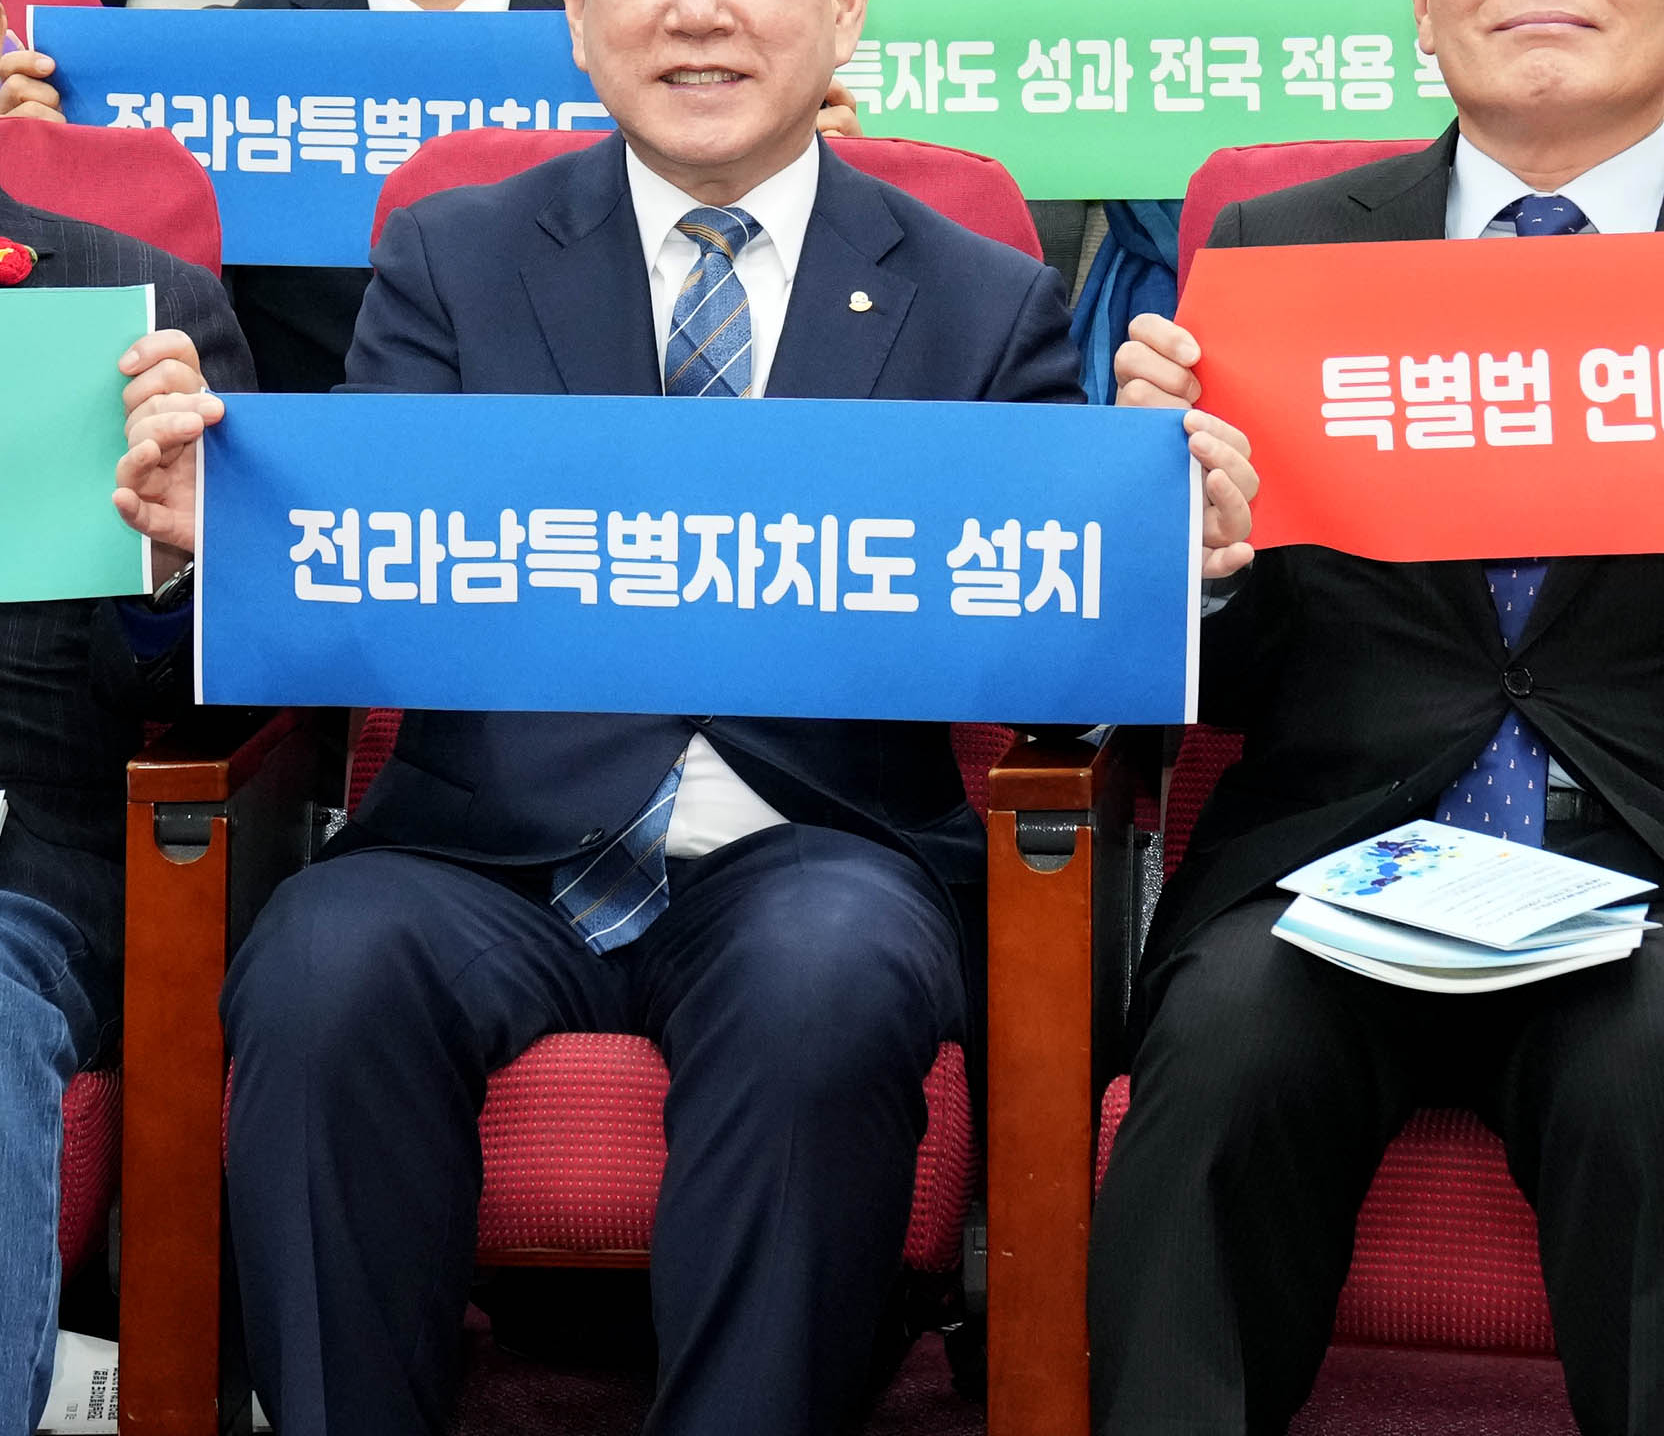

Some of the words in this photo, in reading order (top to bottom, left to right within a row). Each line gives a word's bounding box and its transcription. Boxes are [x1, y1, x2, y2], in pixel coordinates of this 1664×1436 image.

[836, 39, 999, 113] 특자도
[1018, 38, 1132, 113] 성과
[1150, 37, 1262, 112] 전국
[1283, 34, 1395, 110] 적용
[1320, 350, 1553, 451] 특별법
[288, 507, 918, 614] 전라남특별자치도
[946, 517, 1101, 620] 설치
